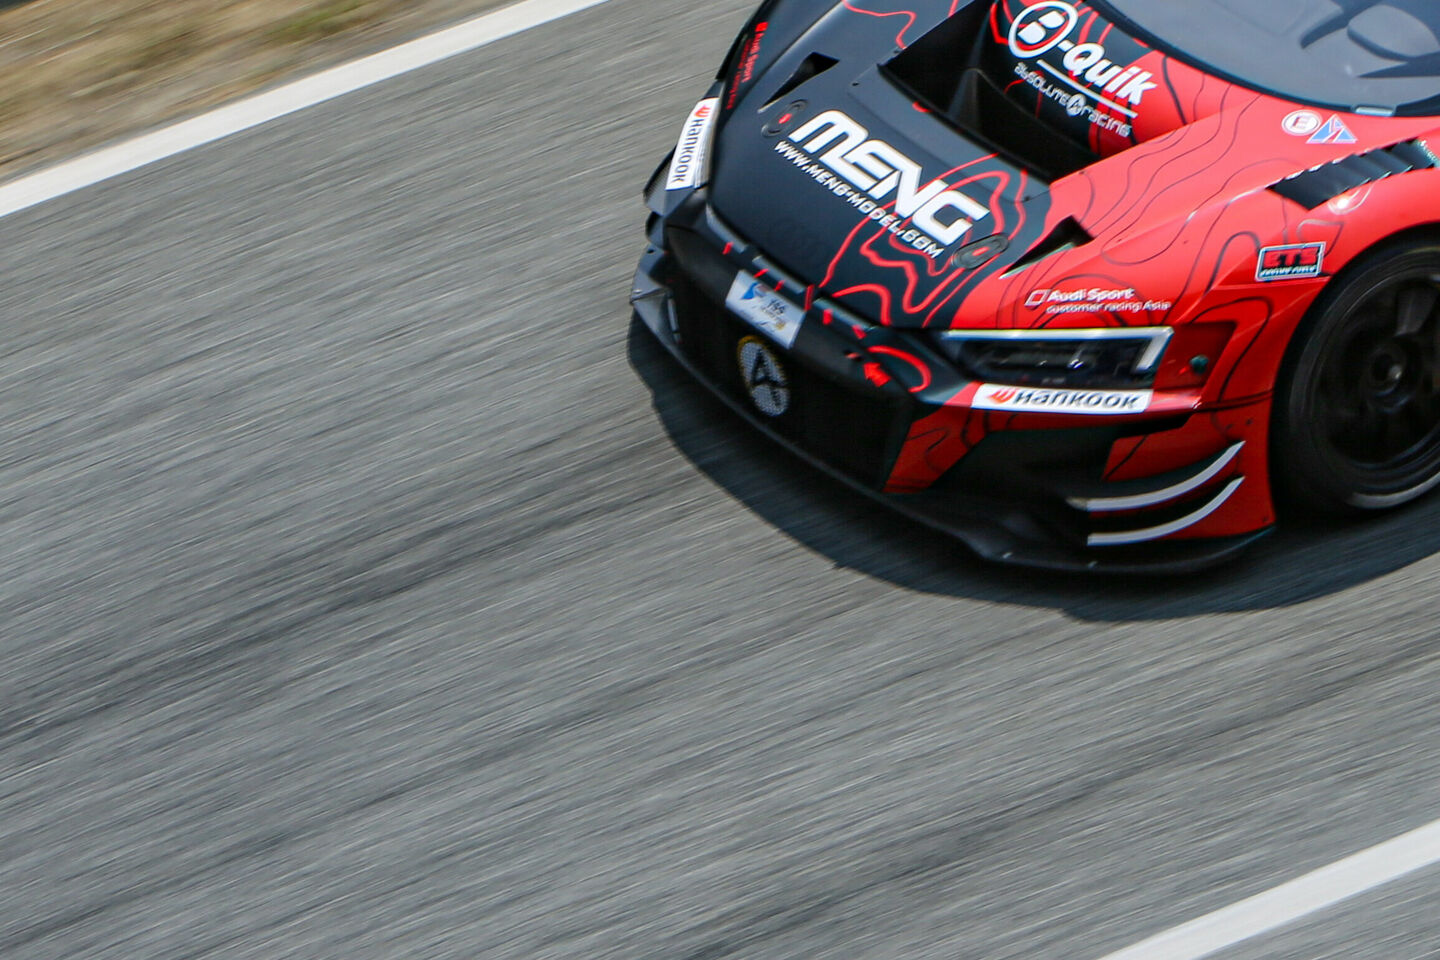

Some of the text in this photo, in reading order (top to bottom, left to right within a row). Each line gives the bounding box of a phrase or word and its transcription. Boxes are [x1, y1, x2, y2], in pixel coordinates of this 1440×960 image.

[788, 109, 991, 247] MENG
[1263, 246, 1320, 268] ETS
[1047, 287, 1136, 303] Audi Sport
[1046, 300, 1172, 314] customer racing Asia
